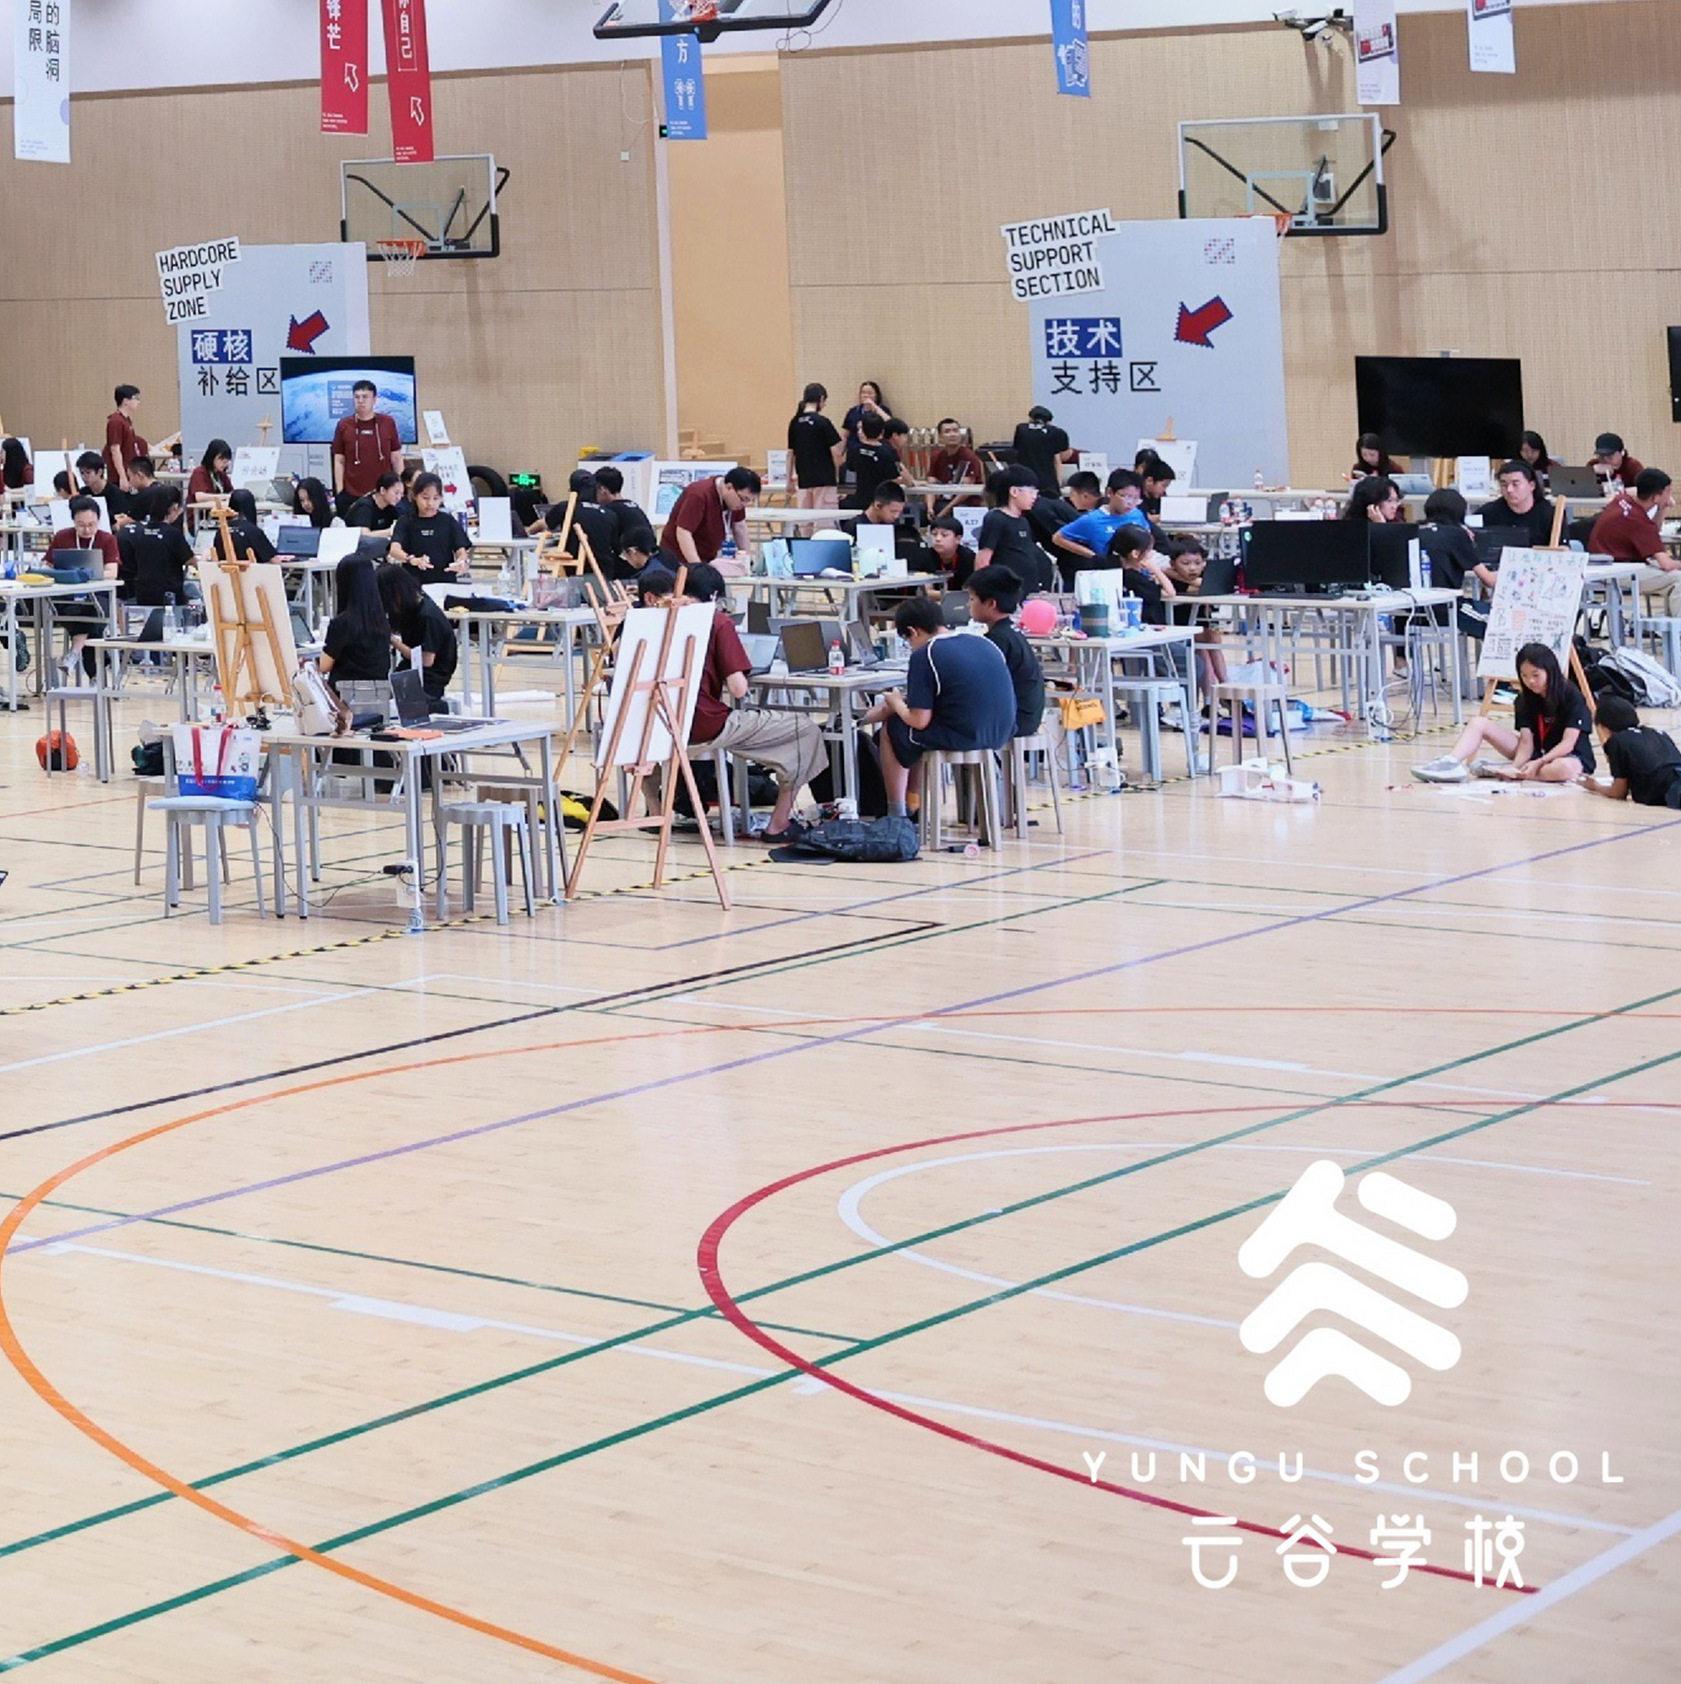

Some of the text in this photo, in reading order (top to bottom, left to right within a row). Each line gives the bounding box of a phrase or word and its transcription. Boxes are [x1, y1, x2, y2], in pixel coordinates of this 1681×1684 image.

[1006, 213, 1115, 247] TECHNICAL
[159, 241, 238, 273] HARDCORE
[1011, 242, 1094, 272] SUPPORT
[164, 269, 221, 297] SUPPLY
[1016, 268, 1100, 298] SECTION
[168, 296, 206, 320] ZONE
[193, 330, 250, 361] 硬核
[1046, 319, 1120, 356] 技术
[198, 366, 280, 396] 补给区
[1051, 360, 1161, 394] 支持区
